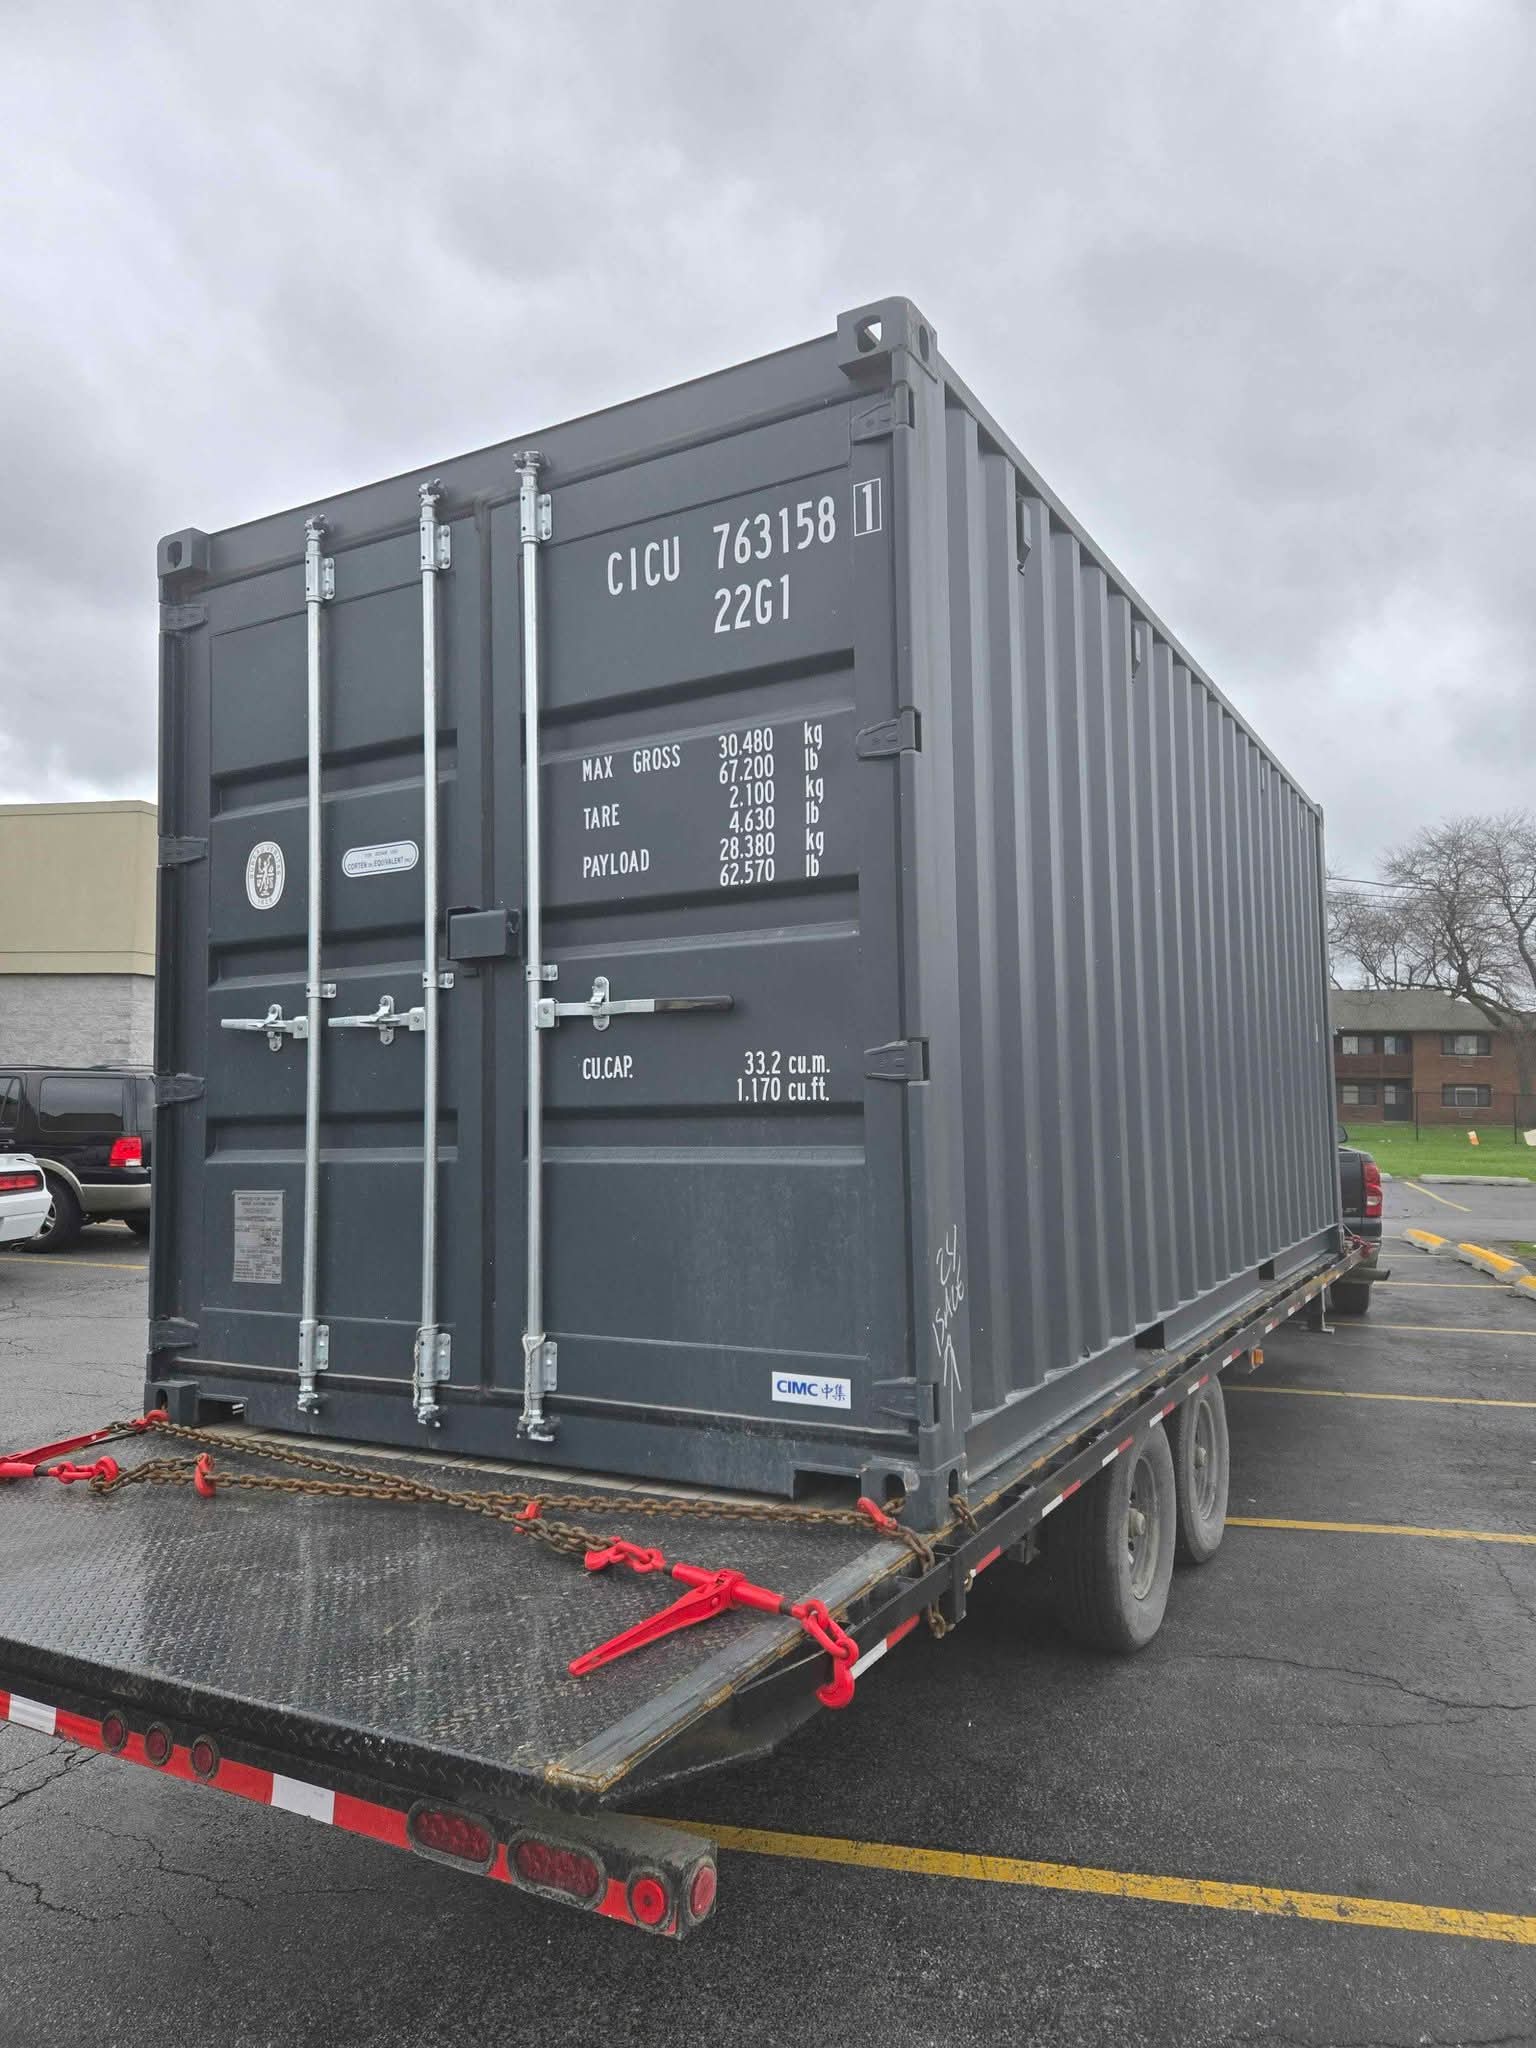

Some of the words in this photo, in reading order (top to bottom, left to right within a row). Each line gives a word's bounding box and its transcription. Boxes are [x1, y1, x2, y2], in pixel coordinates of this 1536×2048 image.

[607, 535, 680, 596] CICU
[712, 495, 836, 570] 763158
[713, 573, 790, 634] 22G1
[582, 755, 614, 782] MAX
[632, 743, 681, 774] GROSS
[718, 727, 774, 760] 30.480
[803, 720, 823, 751] kg
[719, 753, 775, 785] 67.200
[804, 747, 819, 772] lb
[583, 803, 620, 830] TARE
[729, 779, 775, 809] 2.100
[805, 773, 824, 804] kg
[728, 805, 775, 834] 4.630
[805, 800, 820, 825] lb
[582, 848, 650, 879] PAYLOAD
[719, 831, 776, 862] 28.380
[805, 827, 824, 857] kg
[719, 857, 775, 887] 62.570
[805, 853, 820, 878] lb
[582, 1055, 634, 1080] CU.CAP.
[744, 1050, 782, 1076] 33.2
[788, 1054, 831, 1075] cu.m.
[736, 1076, 781, 1103] 1.170
[788, 1075, 830, 1102] cu.ft.
[776, 1379, 818, 1397] CIMC
